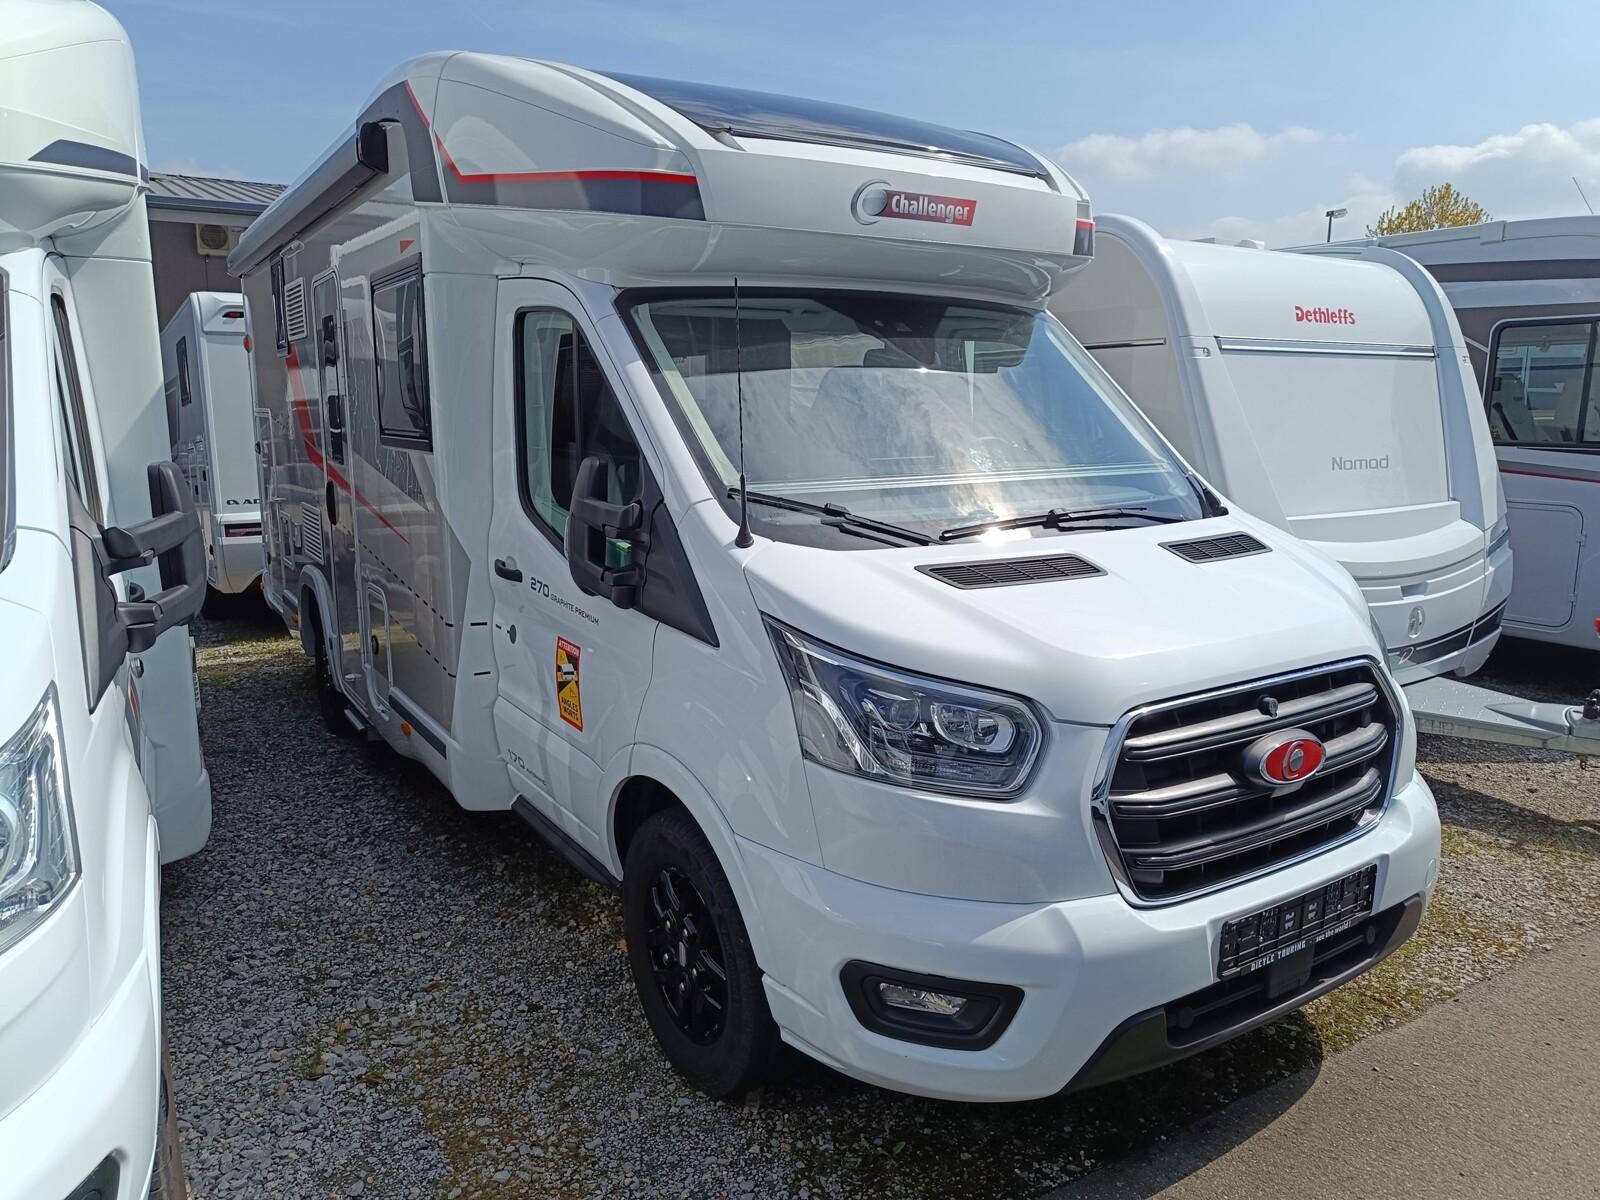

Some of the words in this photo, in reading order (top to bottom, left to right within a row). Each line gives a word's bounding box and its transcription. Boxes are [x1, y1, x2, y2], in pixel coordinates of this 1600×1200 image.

[891, 193, 970, 224] Challenger
[1295, 305, 1356, 325] Dethleffs
[1331, 456, 1389, 471] Nomad
[530, 576, 550, 598] 270
[575, 606, 600, 626] PREMIUM
